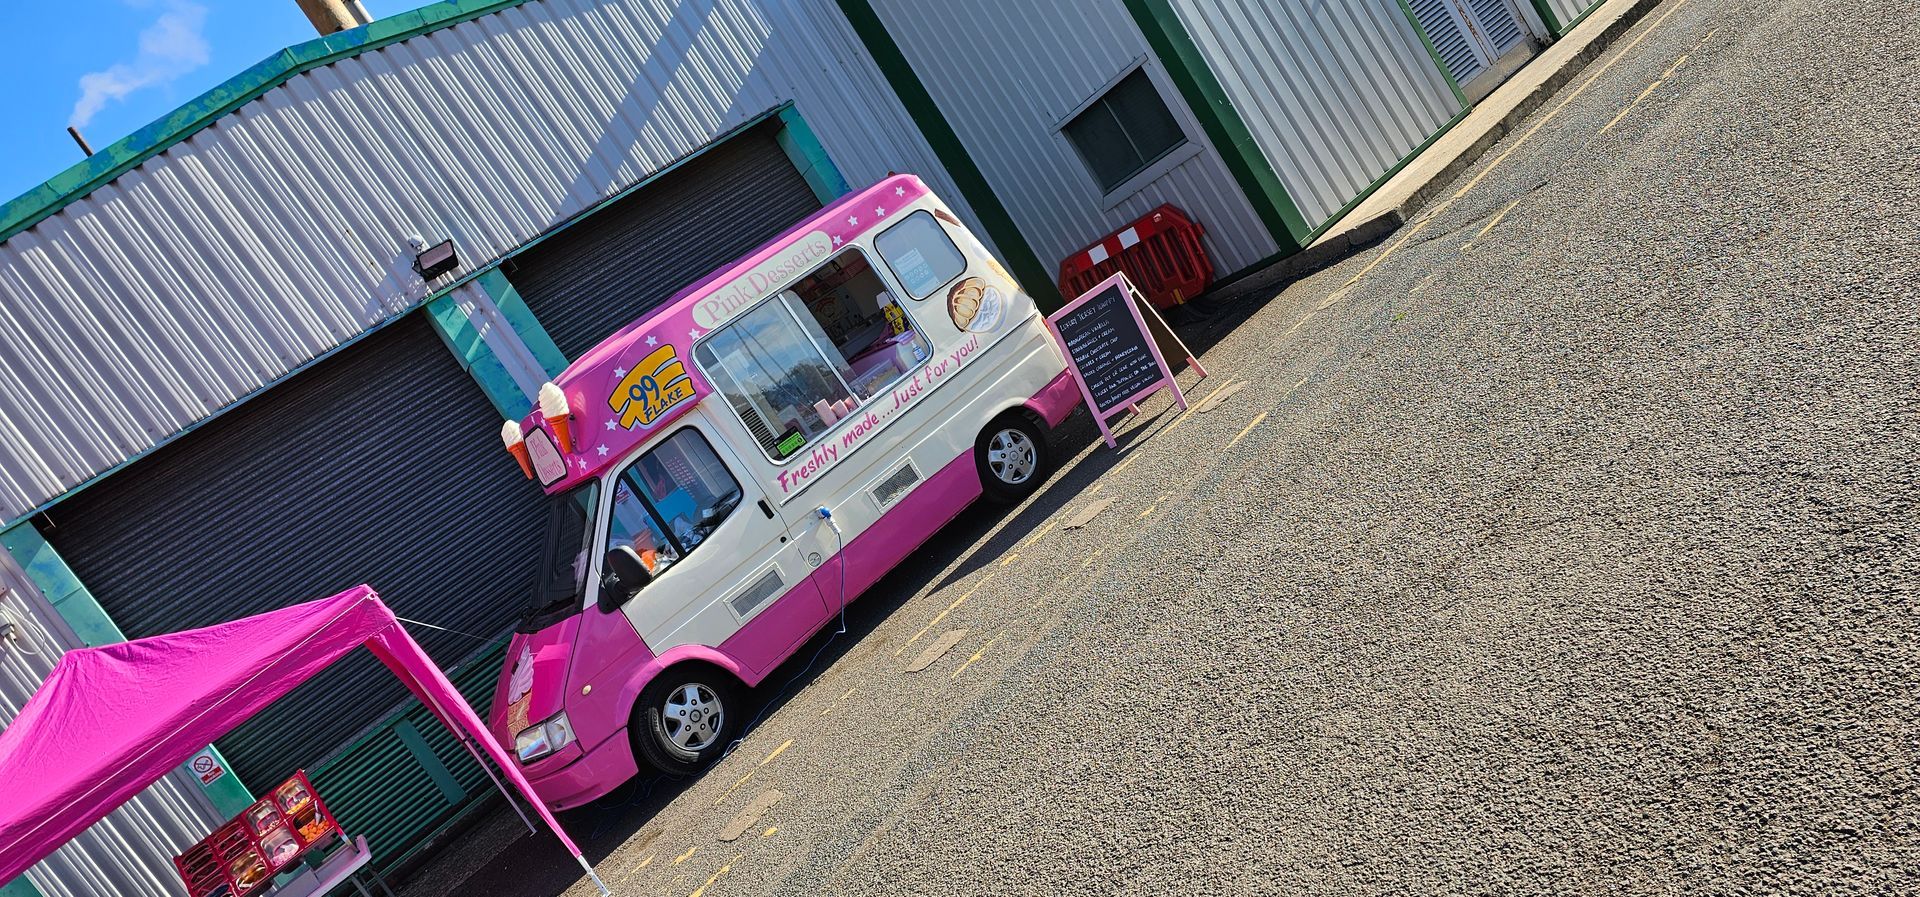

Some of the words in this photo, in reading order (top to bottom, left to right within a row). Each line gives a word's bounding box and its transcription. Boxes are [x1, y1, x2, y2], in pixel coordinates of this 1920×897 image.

[699, 285, 753, 325] Pink
[747, 240, 827, 295] Desserts
[628, 375, 660, 412] 99
[644, 386, 684, 422] FLAKE
[776, 443, 838, 493] Freshly
[842, 412, 880, 449] made
[924, 359, 949, 383] for
[950, 334, 980, 367] you!
